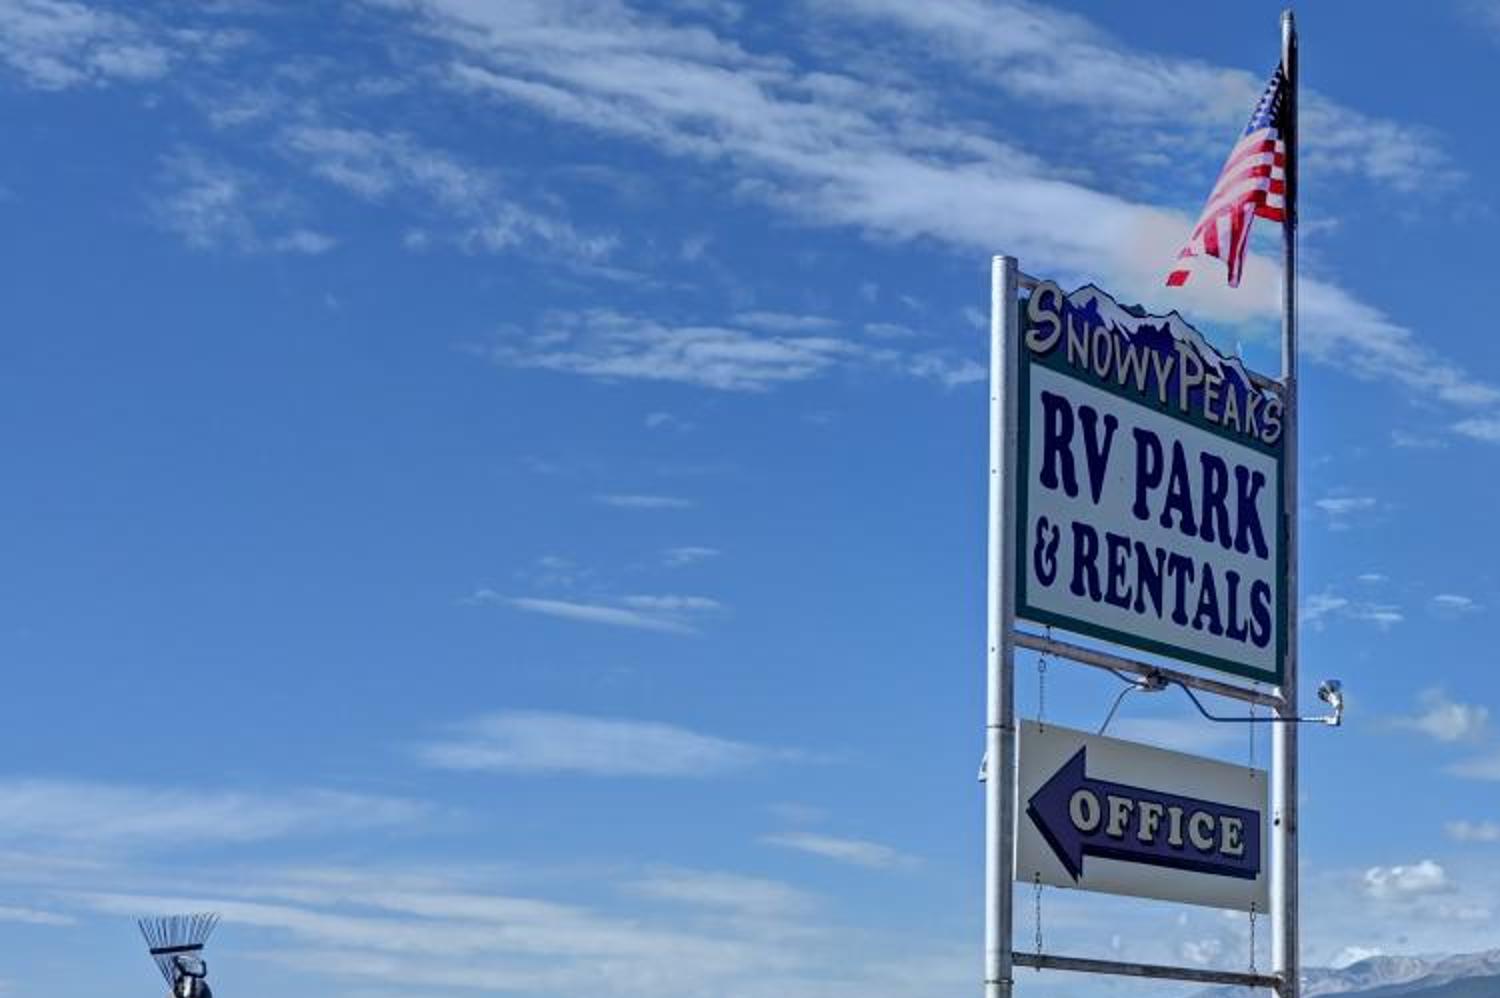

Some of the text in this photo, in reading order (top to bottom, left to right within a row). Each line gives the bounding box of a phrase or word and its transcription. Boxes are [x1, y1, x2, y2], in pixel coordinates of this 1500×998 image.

[1039, 391, 1270, 560] RV PARK
[1034, 515, 1271, 650] & RENTALS
[1068, 789, 1245, 856] OFFICE
